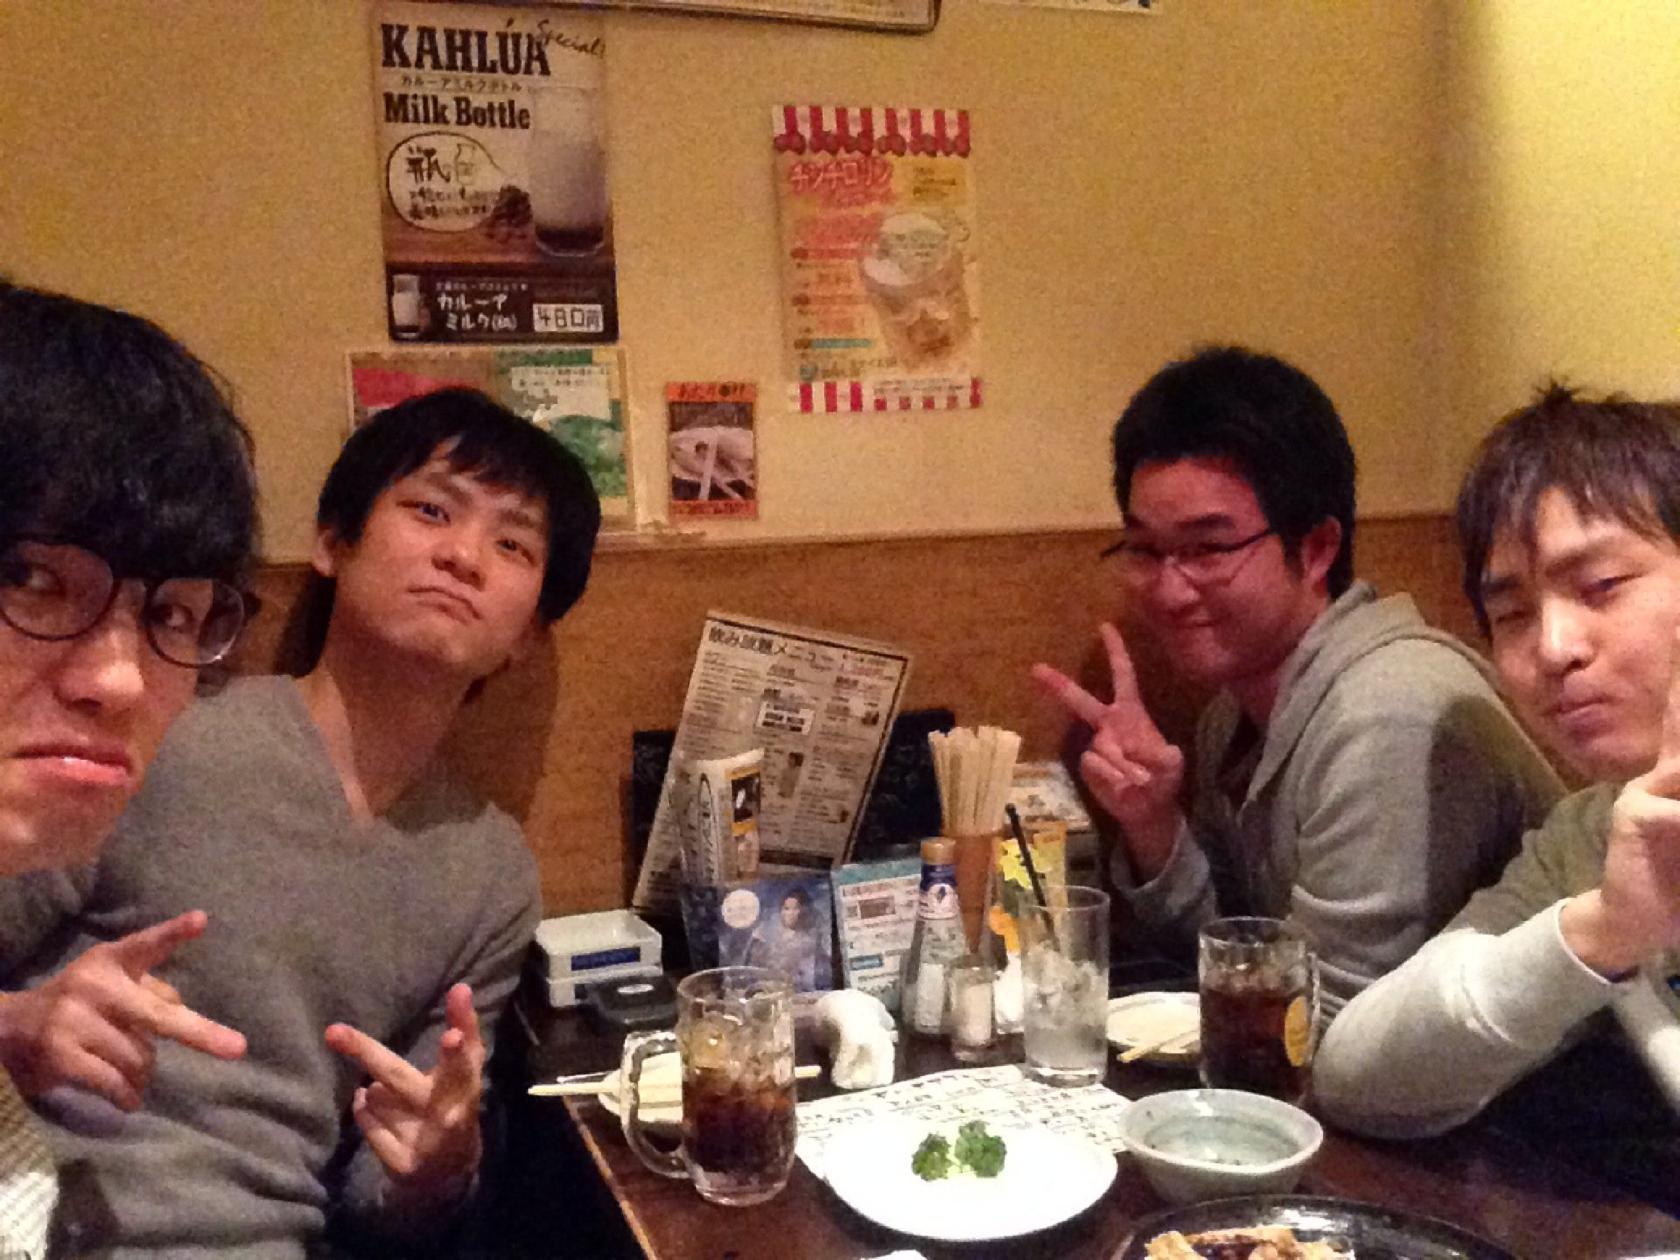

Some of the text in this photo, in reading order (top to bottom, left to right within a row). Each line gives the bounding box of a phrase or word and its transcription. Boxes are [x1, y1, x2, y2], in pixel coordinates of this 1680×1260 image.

[381, 18, 551, 76] KAHLÚA
[383, 92, 531, 130] Milk Bottle
[437, 293, 508, 311] カルーア
[537, 307, 600, 331] 480円
